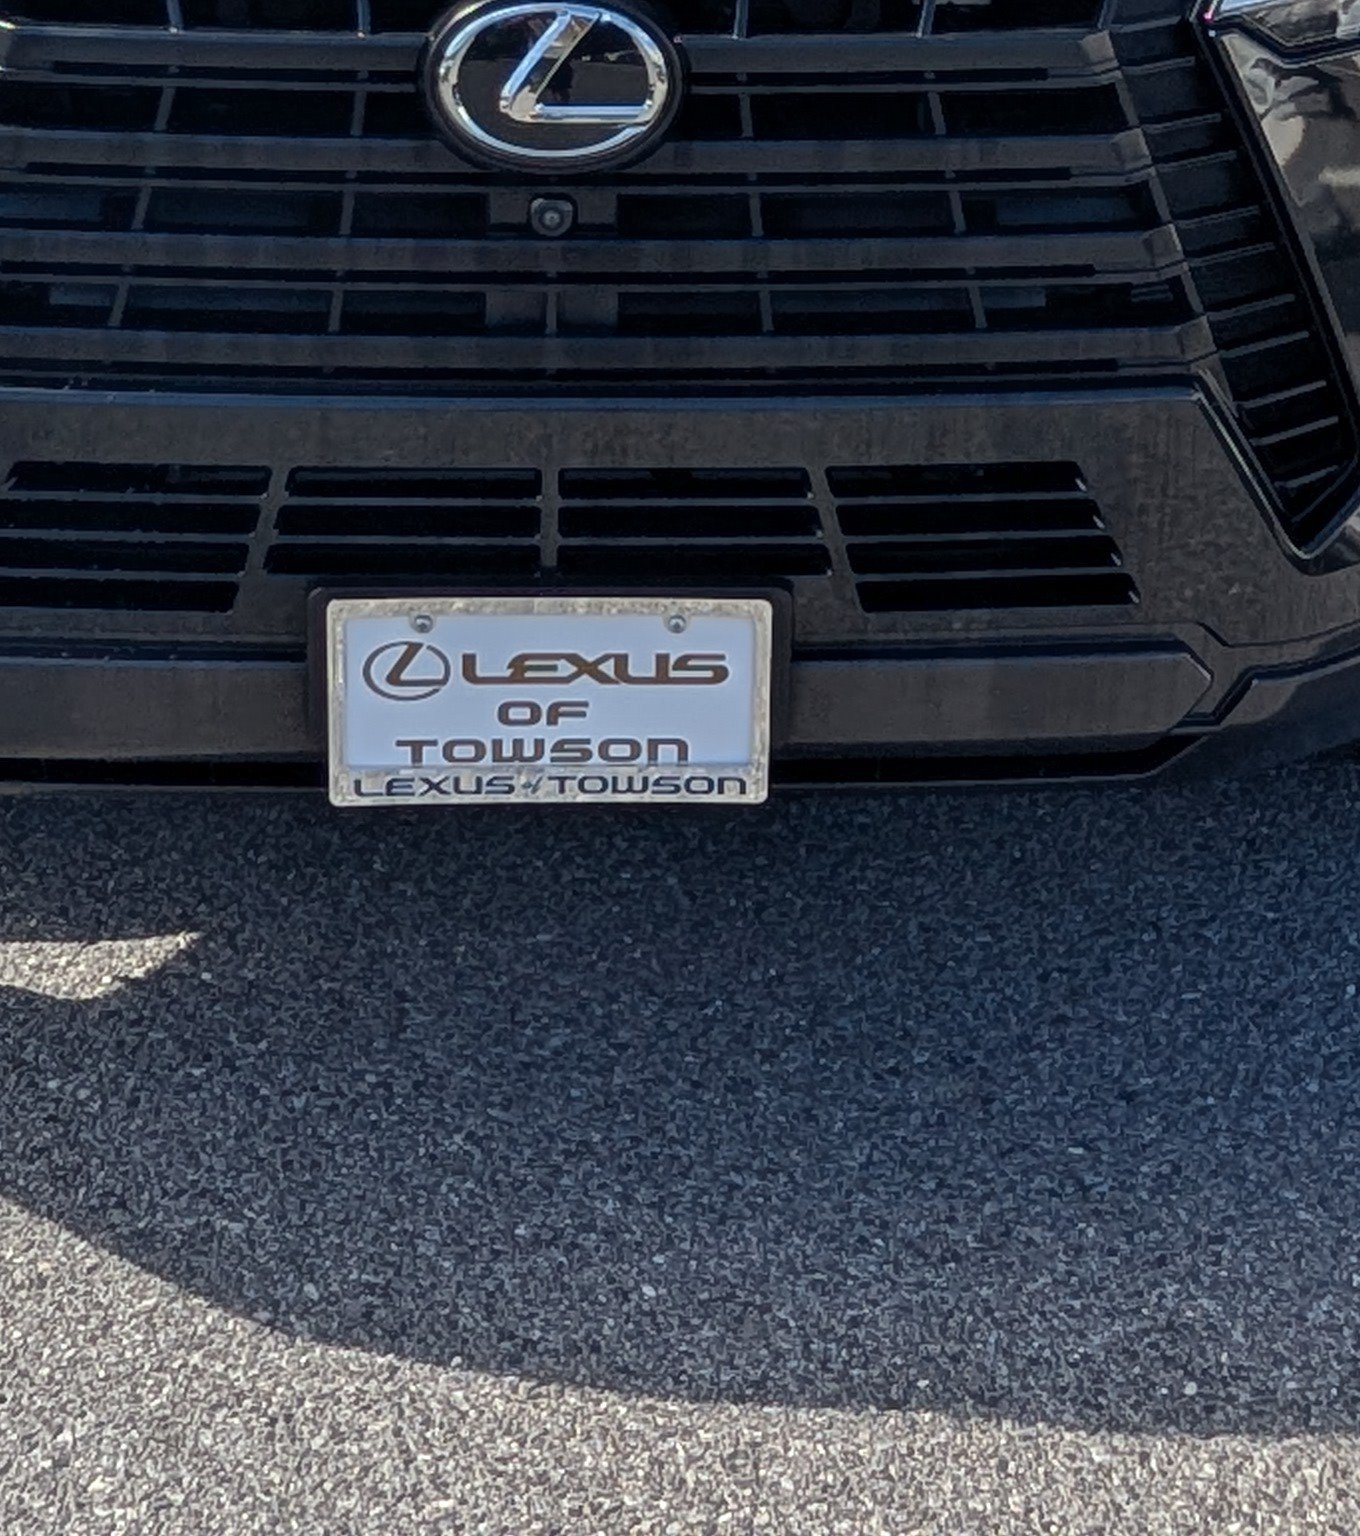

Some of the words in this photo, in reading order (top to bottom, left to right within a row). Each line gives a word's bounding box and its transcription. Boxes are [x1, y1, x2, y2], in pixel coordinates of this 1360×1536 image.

[462, 653, 729, 685] LEXUS
[497, 701, 589, 726] OF
[396, 738, 688, 765] TOWSON
[354, 776, 515, 797] LEXUS
[548, 776, 746, 795] TOWSON
